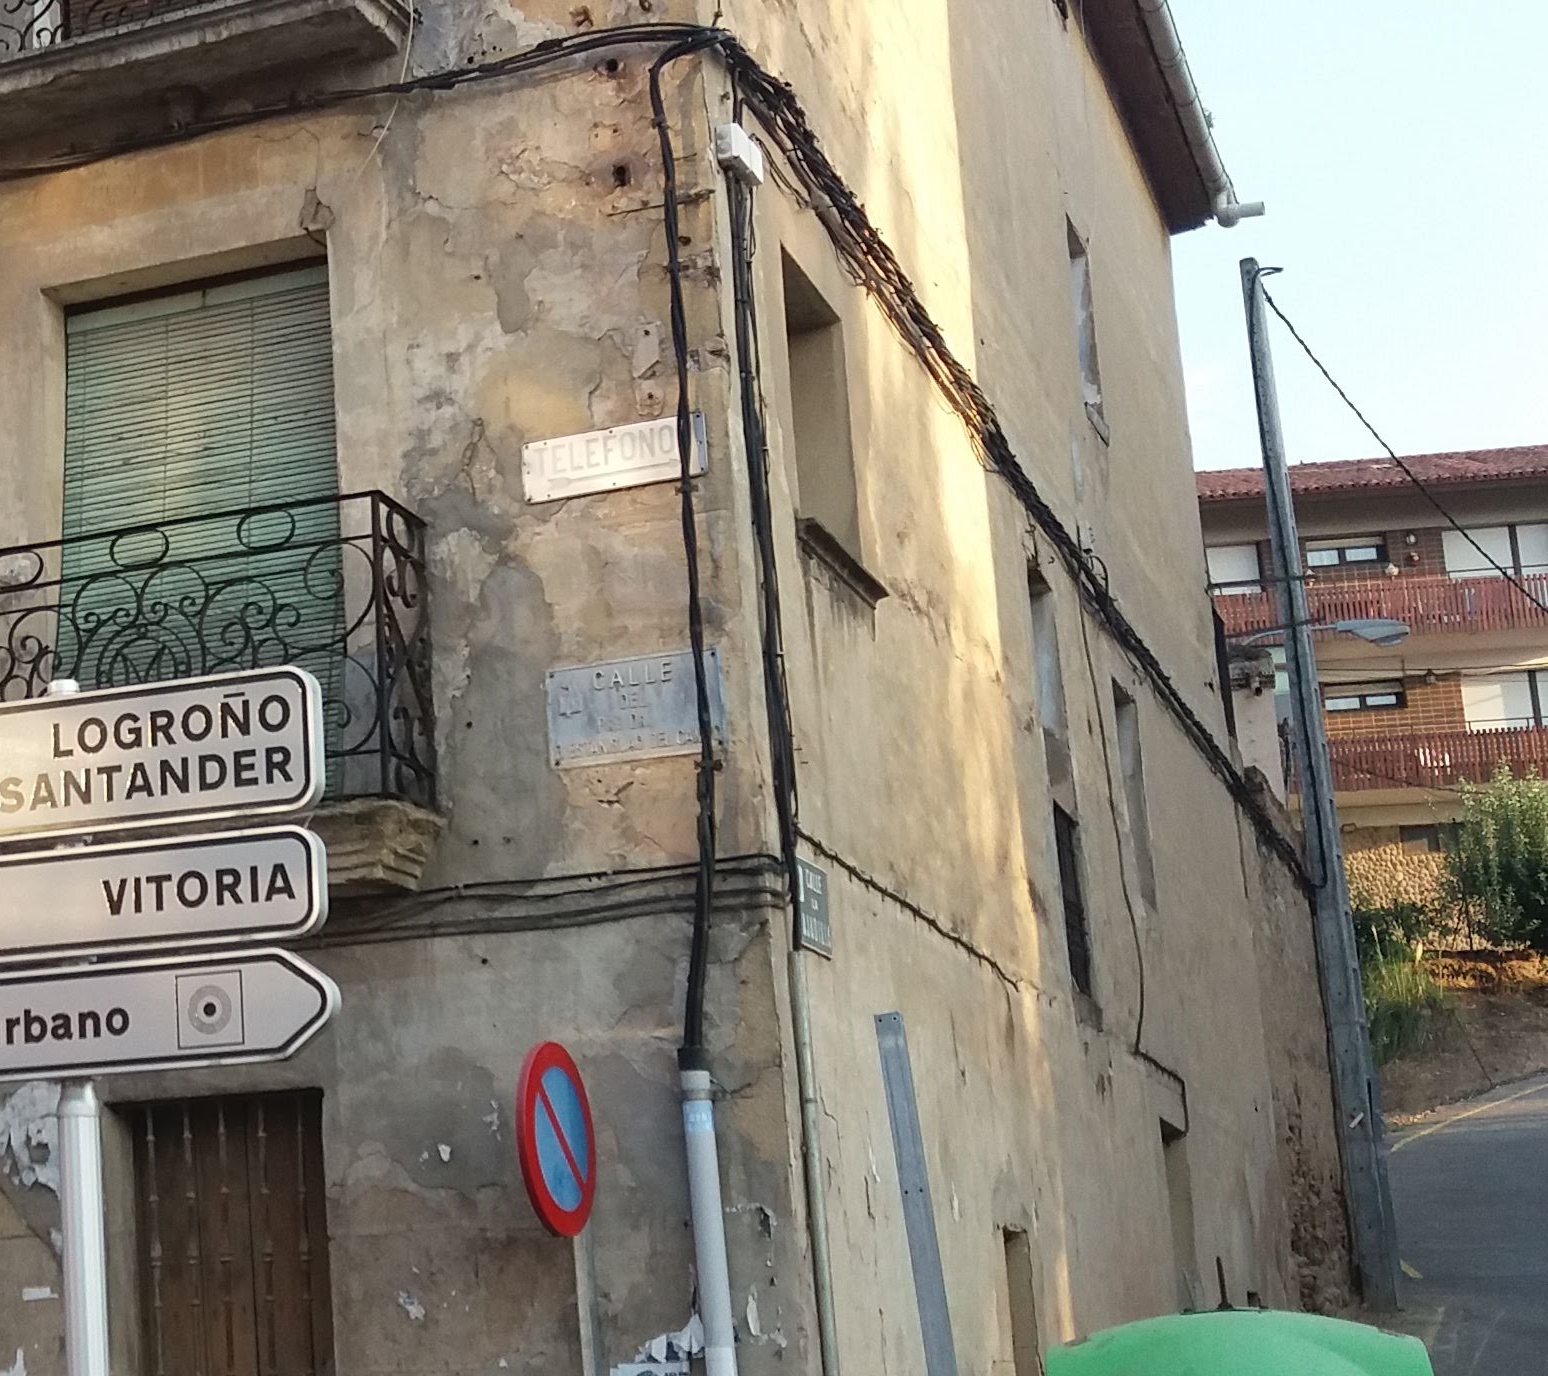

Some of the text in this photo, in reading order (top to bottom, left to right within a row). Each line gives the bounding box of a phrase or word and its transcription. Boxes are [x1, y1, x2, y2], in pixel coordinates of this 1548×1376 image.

[532, 424, 675, 475] TELEFONO
[593, 662, 673, 691] CALLE
[52, 691, 291, 760] LOGROÑO
[101, 862, 297, 916] VITORIA
